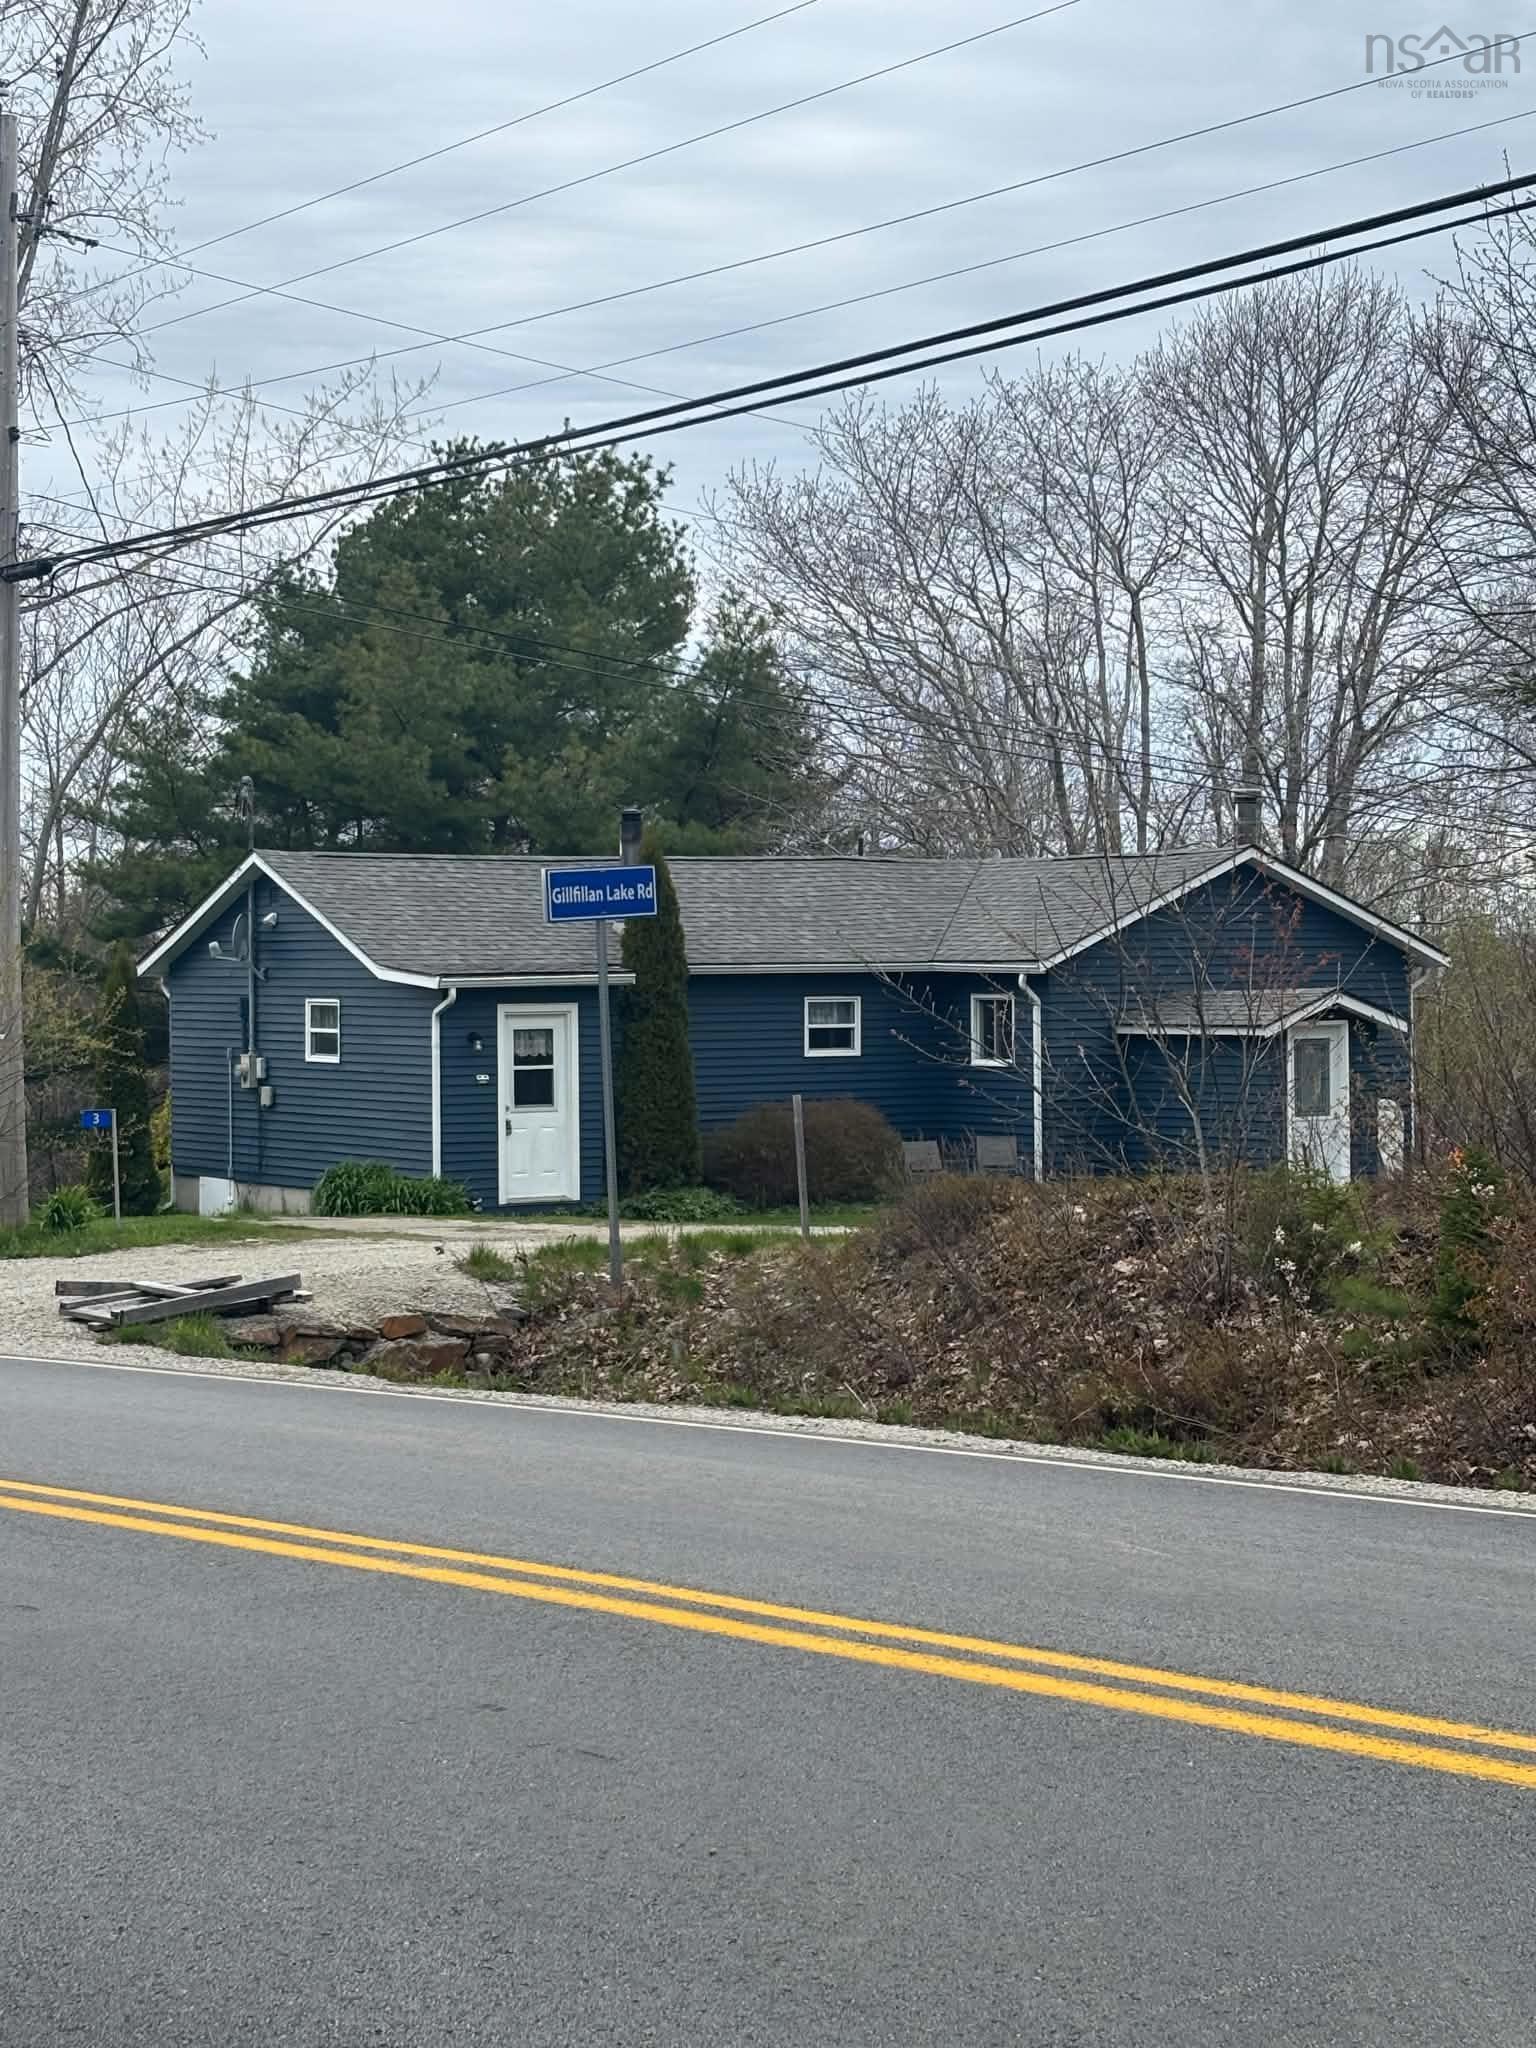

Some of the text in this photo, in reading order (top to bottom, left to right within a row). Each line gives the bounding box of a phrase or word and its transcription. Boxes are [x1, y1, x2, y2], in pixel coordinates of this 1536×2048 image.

[606, 883, 635, 901] Lake
[637, 882, 653, 899] Rd
[92, 1112, 100, 1125] 3
